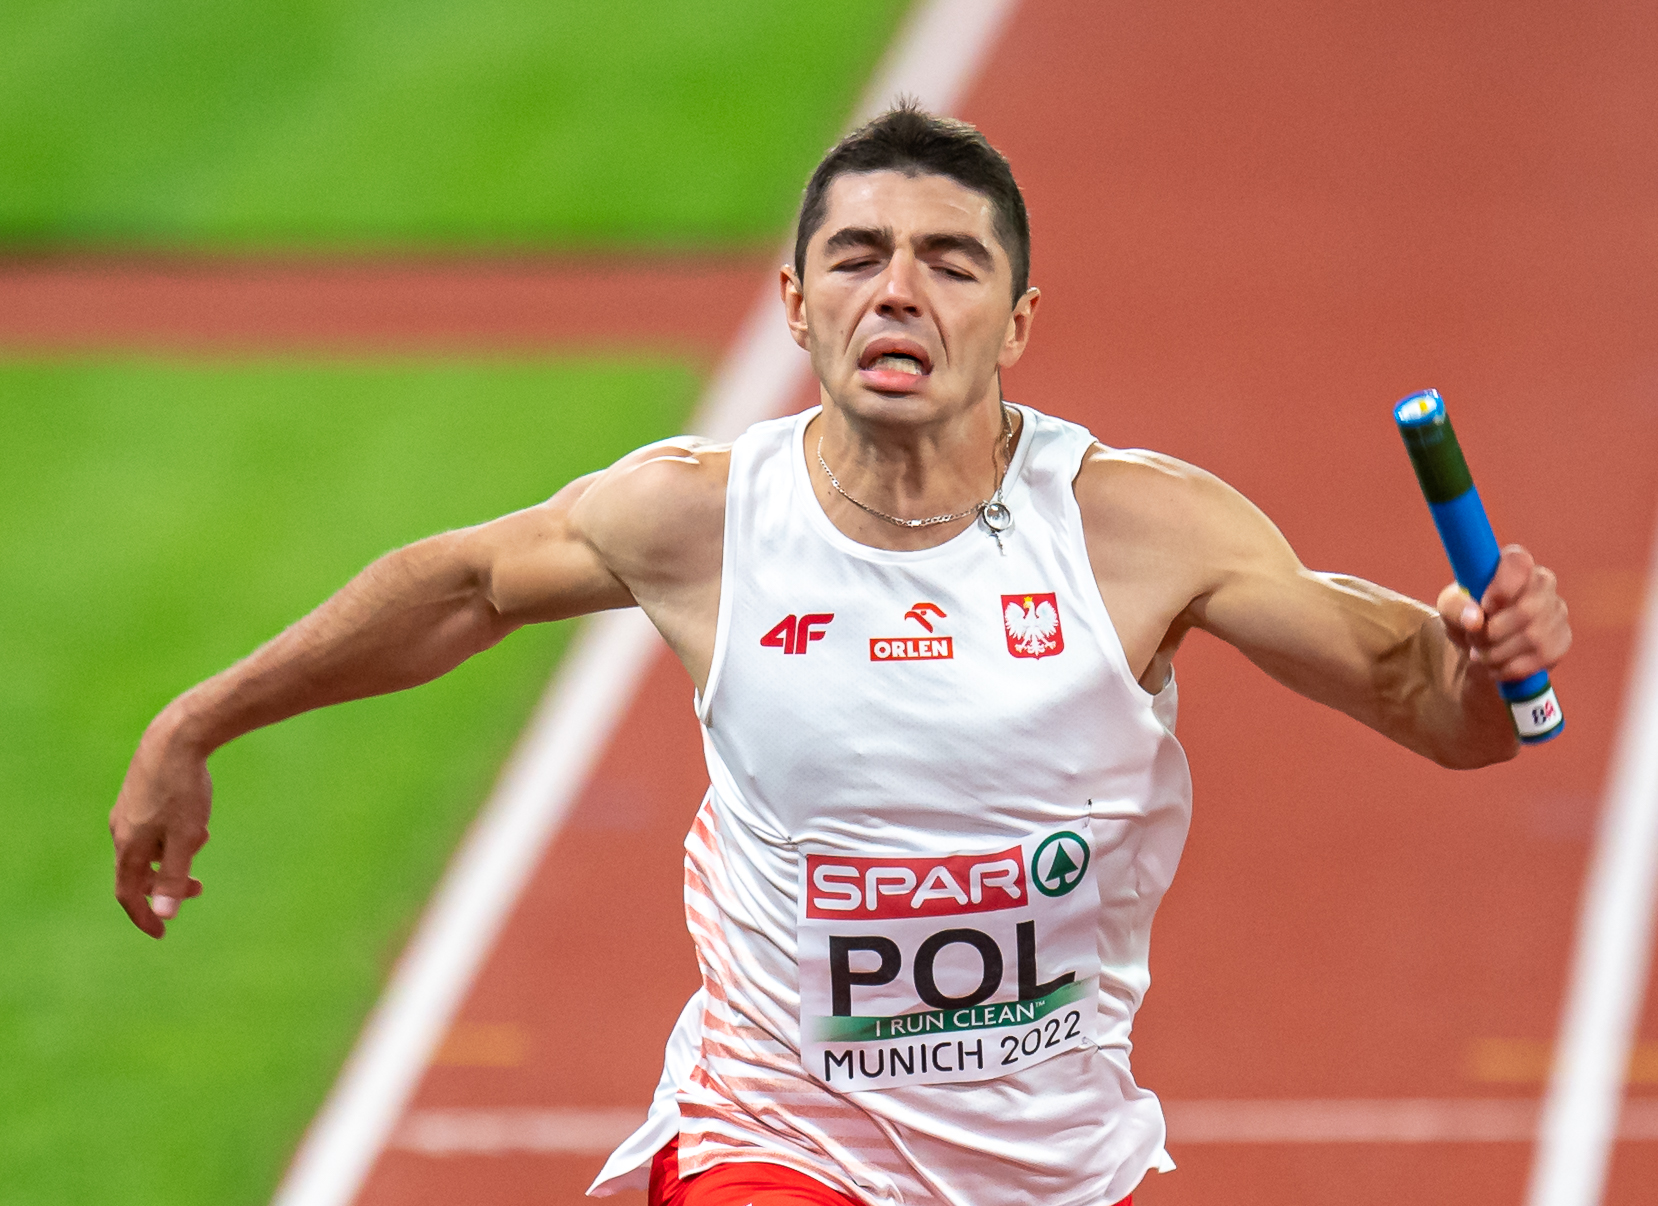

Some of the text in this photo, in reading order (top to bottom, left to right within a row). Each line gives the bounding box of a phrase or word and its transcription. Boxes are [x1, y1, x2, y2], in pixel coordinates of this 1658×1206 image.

[760, 613, 834, 654] 4F
[873, 640, 949, 658] ORLEN
[813, 858, 1021, 911] SPAR
[829, 920, 1076, 1017] POL
[824, 1010, 1081, 1081] MUNICH 2022
[875, 1020, 881, 1037] I
[890, 1012, 944, 1036] RUN
